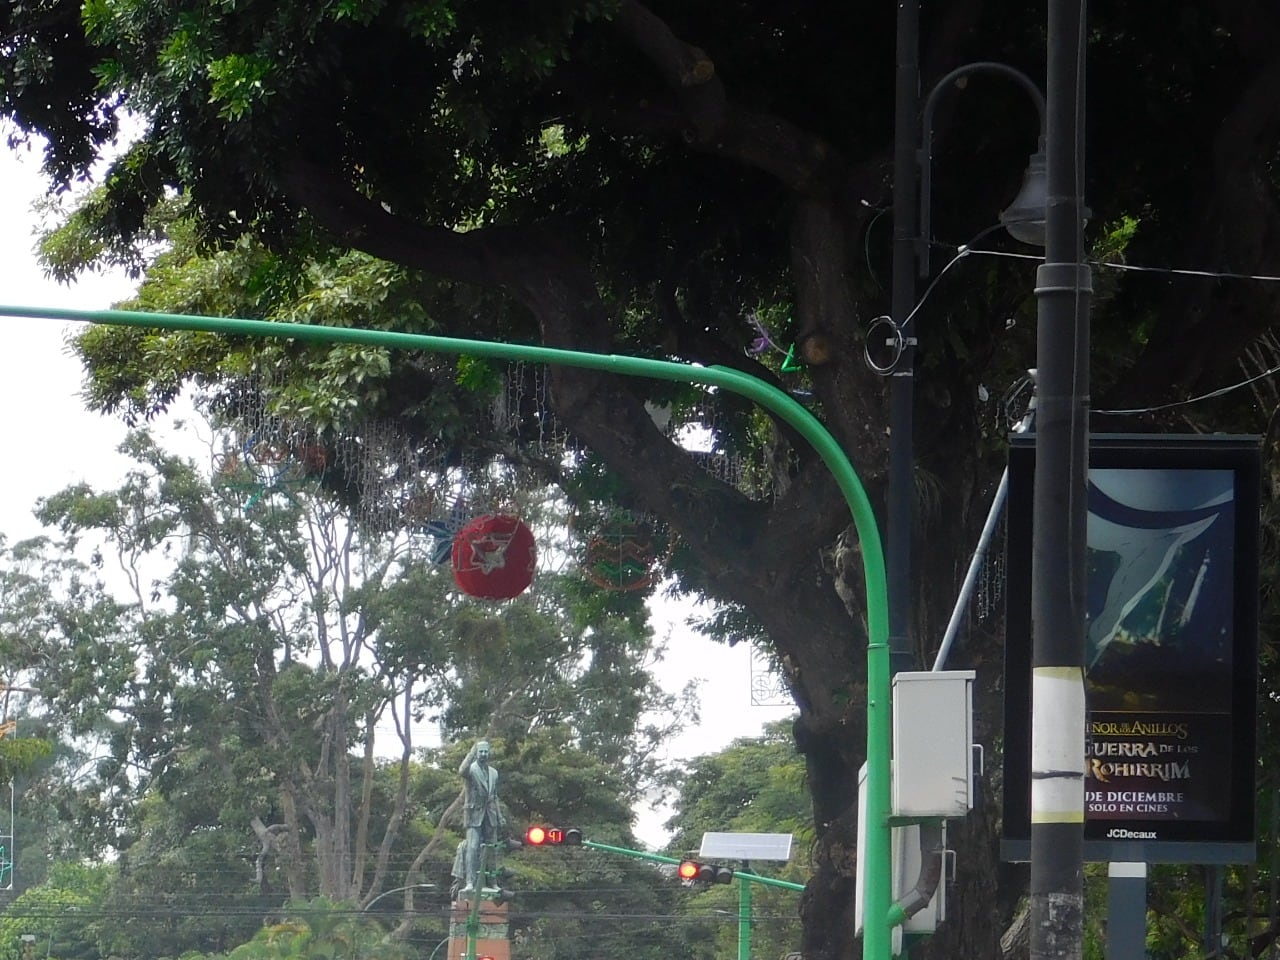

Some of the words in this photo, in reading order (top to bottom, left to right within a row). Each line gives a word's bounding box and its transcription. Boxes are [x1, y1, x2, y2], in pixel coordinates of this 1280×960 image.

[1131, 721, 1188, 739] ANILLOS
[1160, 744, 1174, 753] DE
[1177, 745, 1199, 753] LOS
[1085, 758, 1191, 783] ROHIRRIM
[1107, 792, 1184, 802] DICIEMBRE
[1089, 803, 1116, 812] SOLO
[1120, 804, 1134, 812] EN
[1136, 804, 1168, 813] CINES
[1106, 829, 1157, 839] JCDecaux
